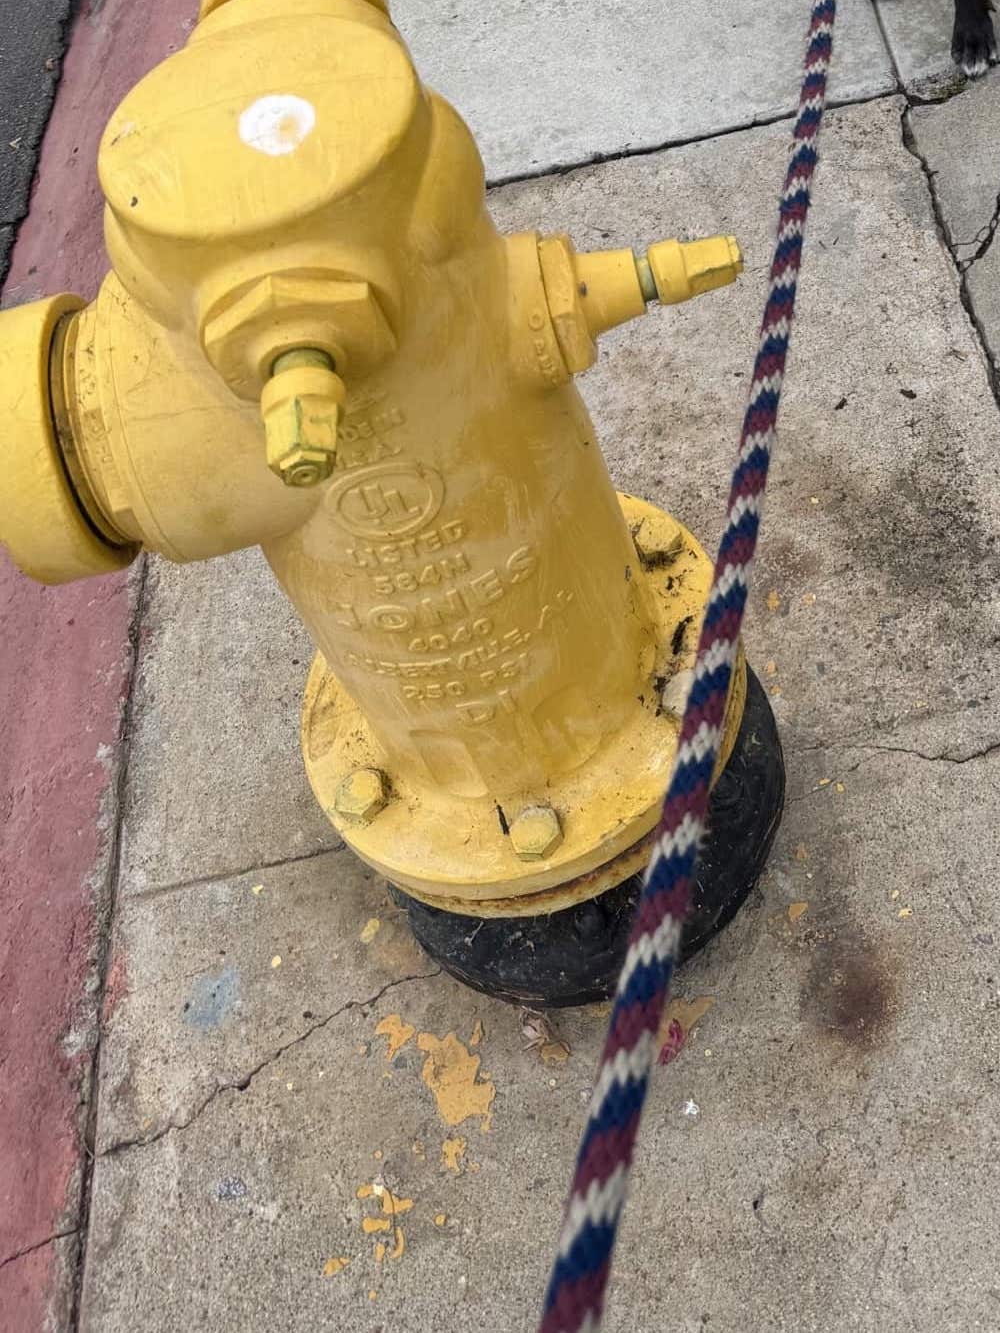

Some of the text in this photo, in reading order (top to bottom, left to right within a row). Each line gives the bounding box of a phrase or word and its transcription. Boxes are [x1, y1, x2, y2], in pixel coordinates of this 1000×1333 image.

[345, 519, 466, 568] LISTED
[335, 545, 536, 632] JONES
[407, 617, 495, 656] 4040
[401, 680, 466, 702] 250
